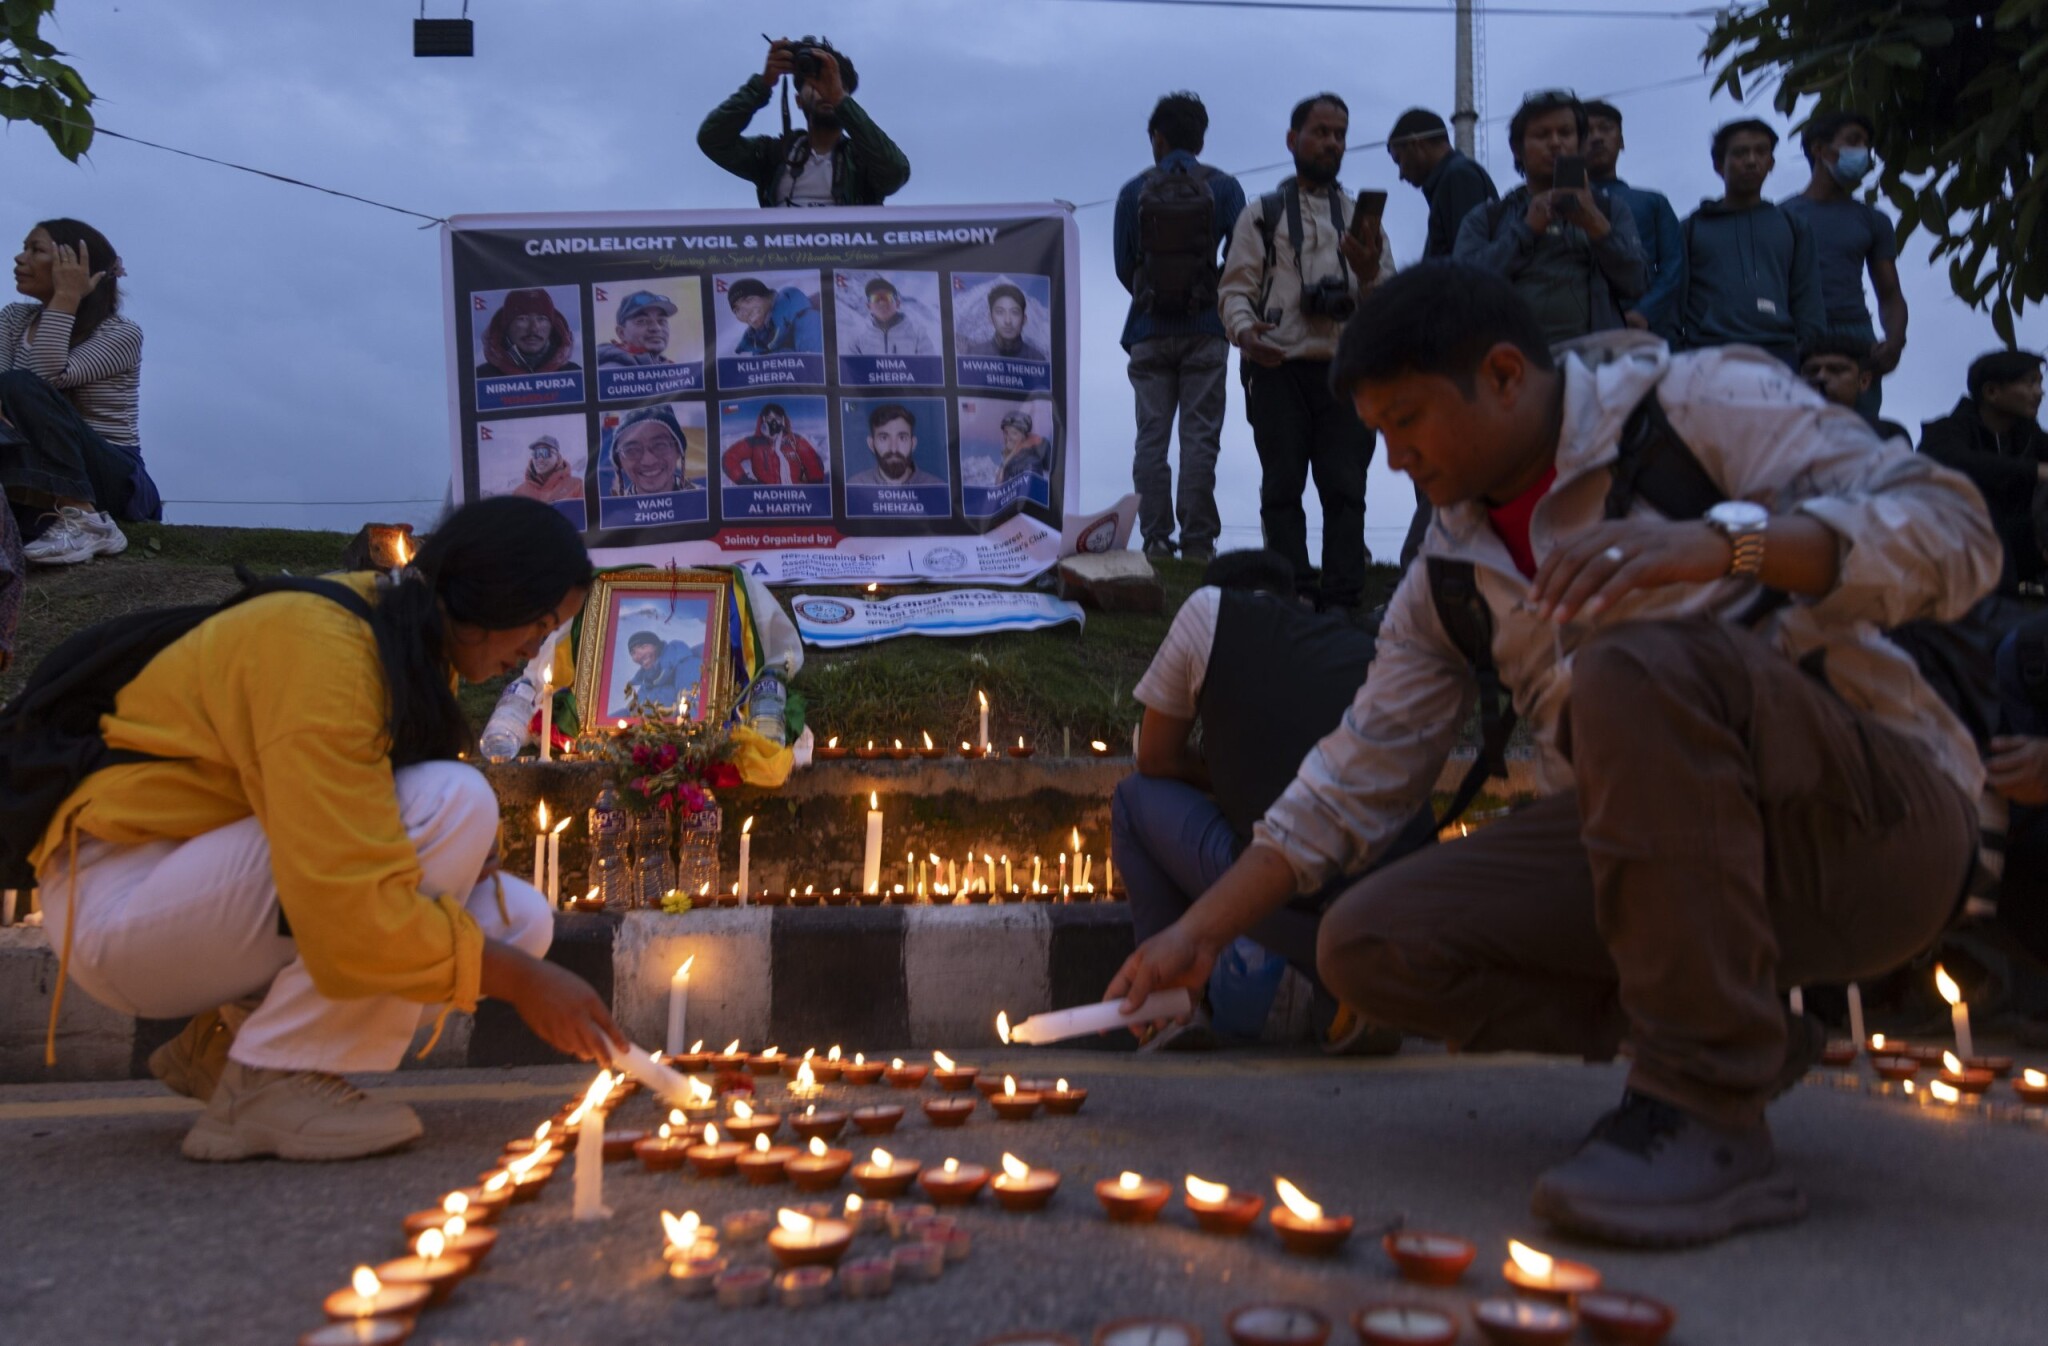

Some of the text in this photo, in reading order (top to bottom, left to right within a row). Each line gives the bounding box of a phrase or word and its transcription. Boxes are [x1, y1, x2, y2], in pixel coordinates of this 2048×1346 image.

[525, 227, 998, 256] CANDLELIGHT VIGIL & MEMORIAL CEREMONY
[722, 252, 754, 266] Spirit
[737, 358, 805, 373] KILI PEMBA
[875, 359, 907, 369] NIMA
[1006, 363, 1045, 375] THENDU
[612, 367, 690, 382] PUR BAHADUR
[747, 372, 795, 384] SHERPA
[868, 372, 915, 383] SHERPA
[986, 374, 1024, 387] SHERPA
[486, 378, 576, 394] NIRMAL PURJA
[607, 376, 695, 395] GURUNG (YUKTA)
[987, 475, 1029, 501] MALLORY
[753, 490, 807, 500] NADHIRA
[877, 490, 918, 499] SOHAIL
[636, 498, 673, 510] WANG
[748, 503, 813, 513] AL HARTHY
[872, 502, 924, 513] SHEHZAD
[634, 510, 675, 522] ZHONG
[724, 534, 833, 546] Jointly Organized by:
[993, 531, 1023, 550] Everest
[1029, 530, 1048, 544] Club
[812, 553, 856, 561] Climbing
[859, 553, 885, 561] Sport
[865, 609, 905, 618] Everest
